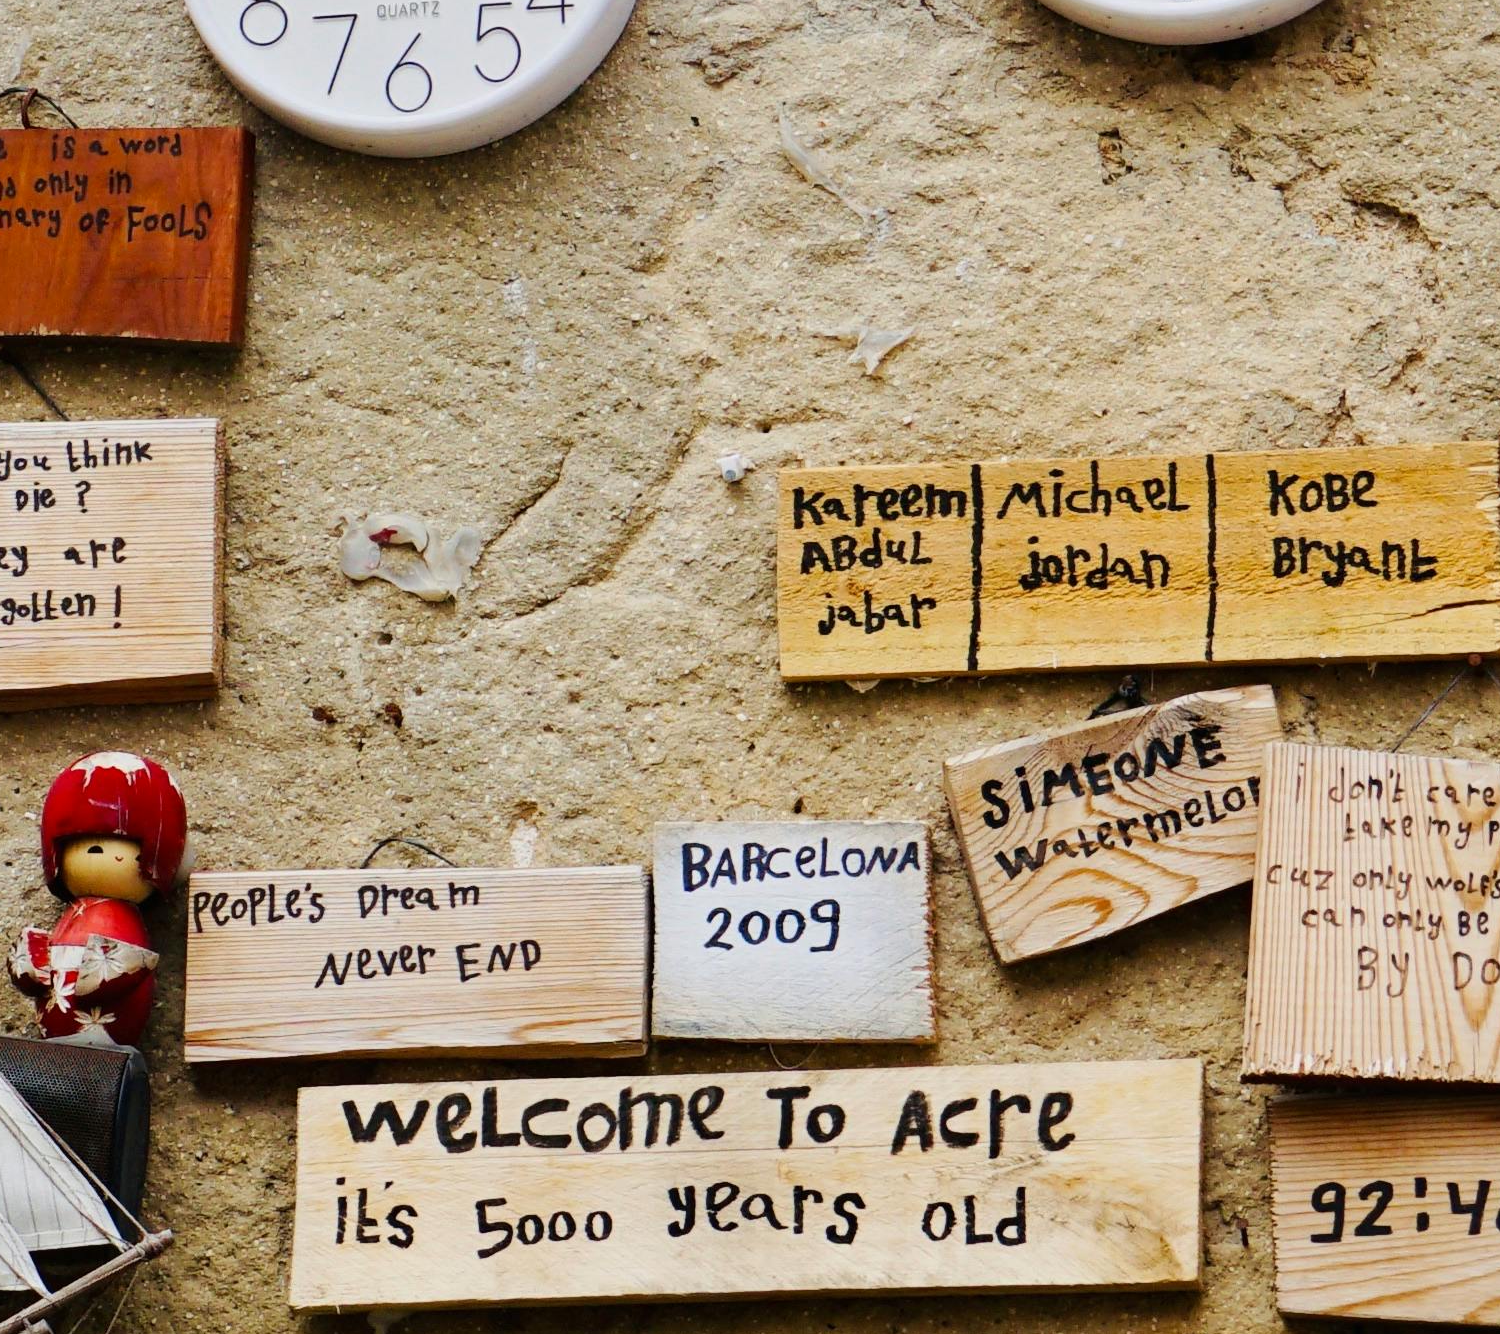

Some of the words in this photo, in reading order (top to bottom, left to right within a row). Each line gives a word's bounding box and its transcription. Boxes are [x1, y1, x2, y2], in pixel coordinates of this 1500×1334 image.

[376, 0, 440, 19] QUARTZ
[51, 134, 73, 159] is
[108, 170, 132, 193] in
[64, 537, 127, 565] are
[705, 899, 840, 953] 2009
[459, 940, 541, 984] END
[476, 1199, 613, 1260] 5000
